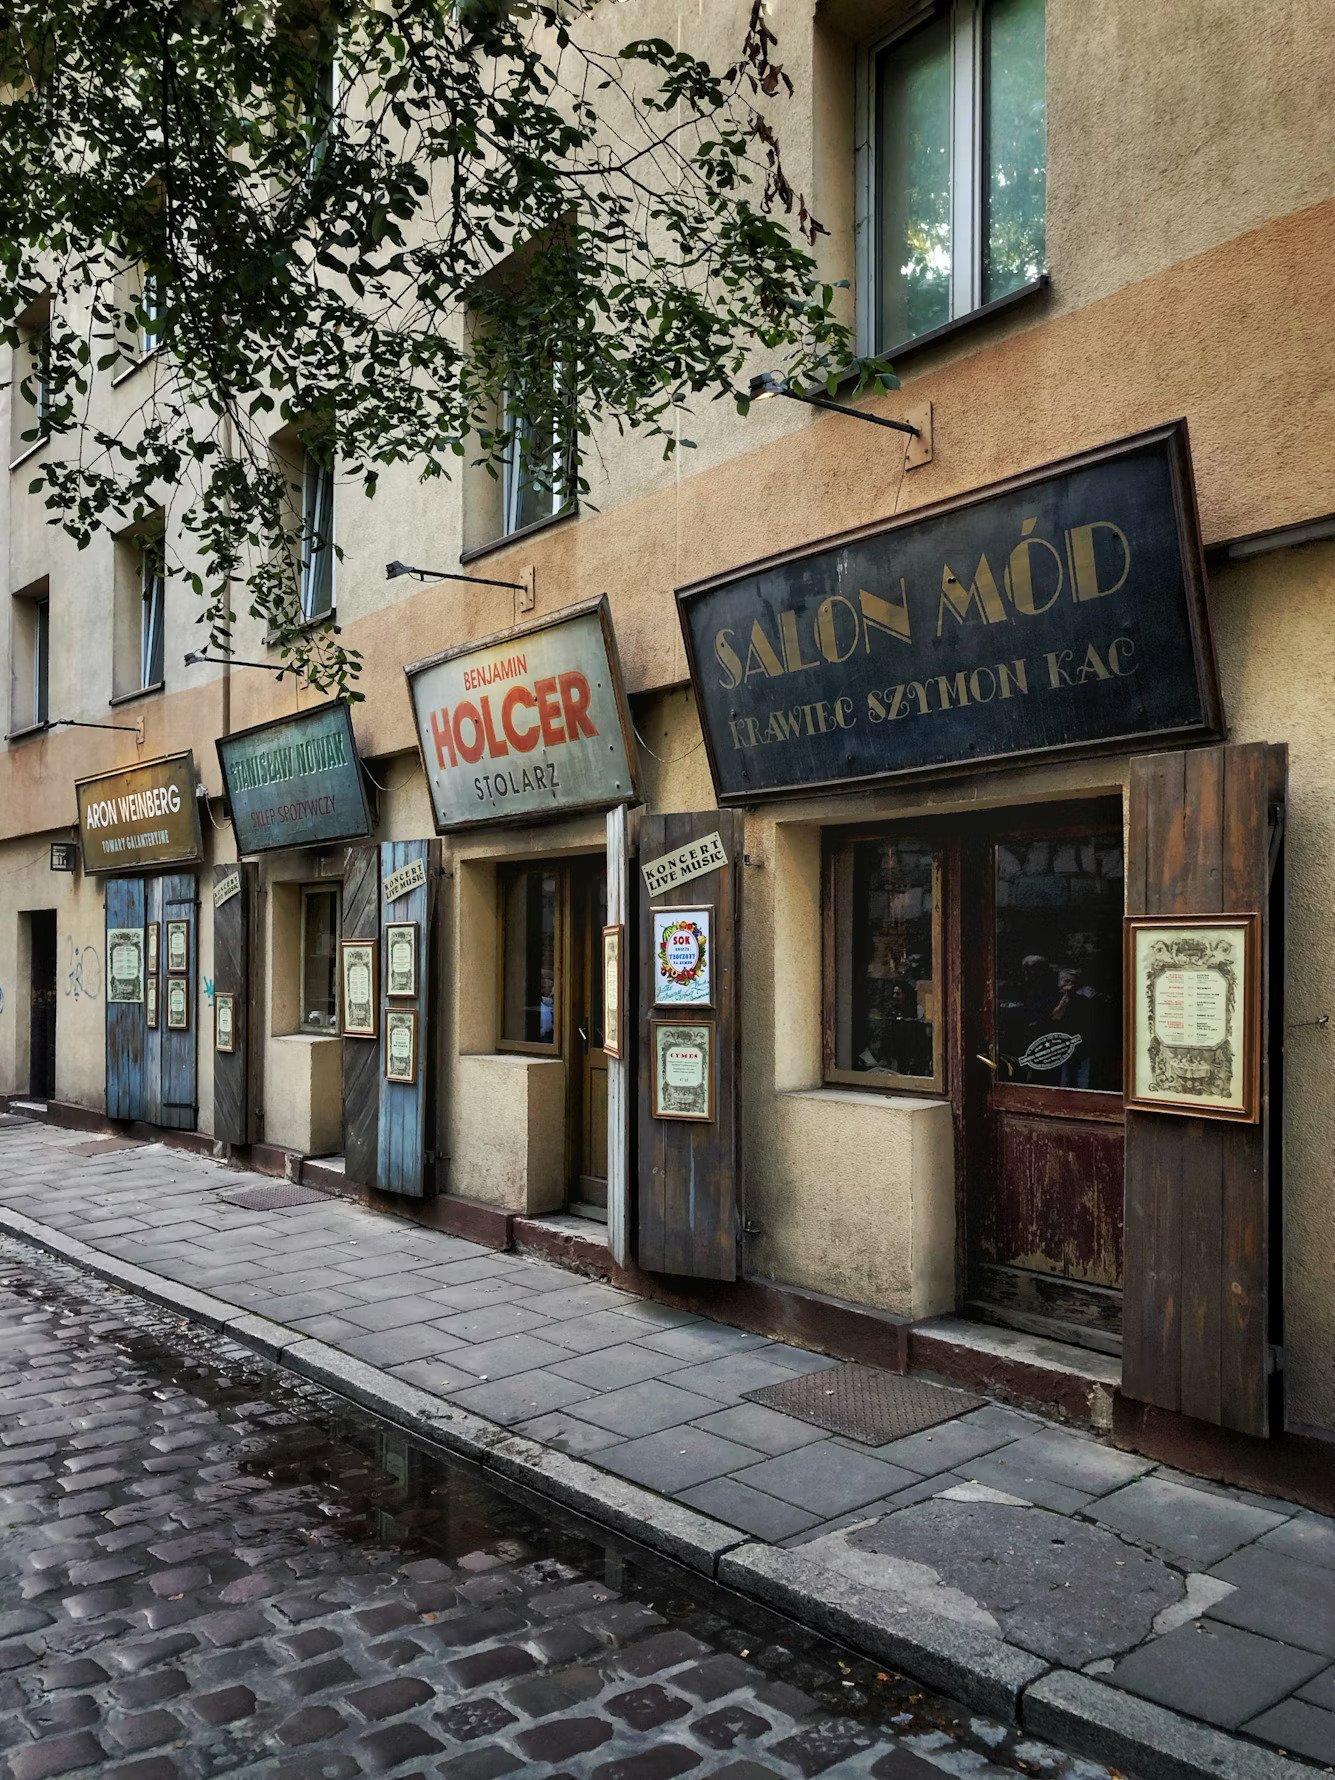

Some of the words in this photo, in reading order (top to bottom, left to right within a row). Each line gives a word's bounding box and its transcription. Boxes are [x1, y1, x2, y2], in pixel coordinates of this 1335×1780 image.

[714, 577, 912, 690] SALON
[937, 516, 1131, 637] MÓD
[463, 654, 528, 691] BENJAMIN
[728, 696, 857, 750] KRAWIEC
[867, 658, 1029, 724] SZYMON
[1043, 637, 1139, 690] KAC
[430, 671, 599, 770] HOLCER
[296, 732, 348, 776] NOWAK
[474, 763, 559, 801] STOLARZ
[87, 799, 118, 830] ARON
[118, 784, 181, 823] WEINBERG
[251, 808, 275, 828] SKLEP
[102, 837, 126, 854] TOWARY
[645, 840, 719, 880] KONCERT
[384, 864, 422, 891] KONCERT
[385, 885, 399, 899] LIVE
[400, 872, 424, 890] MUSIC
[649, 871, 677, 891] LIVE
[680, 851, 723, 876] MUSIC
[673, 936, 691, 945] SOK
